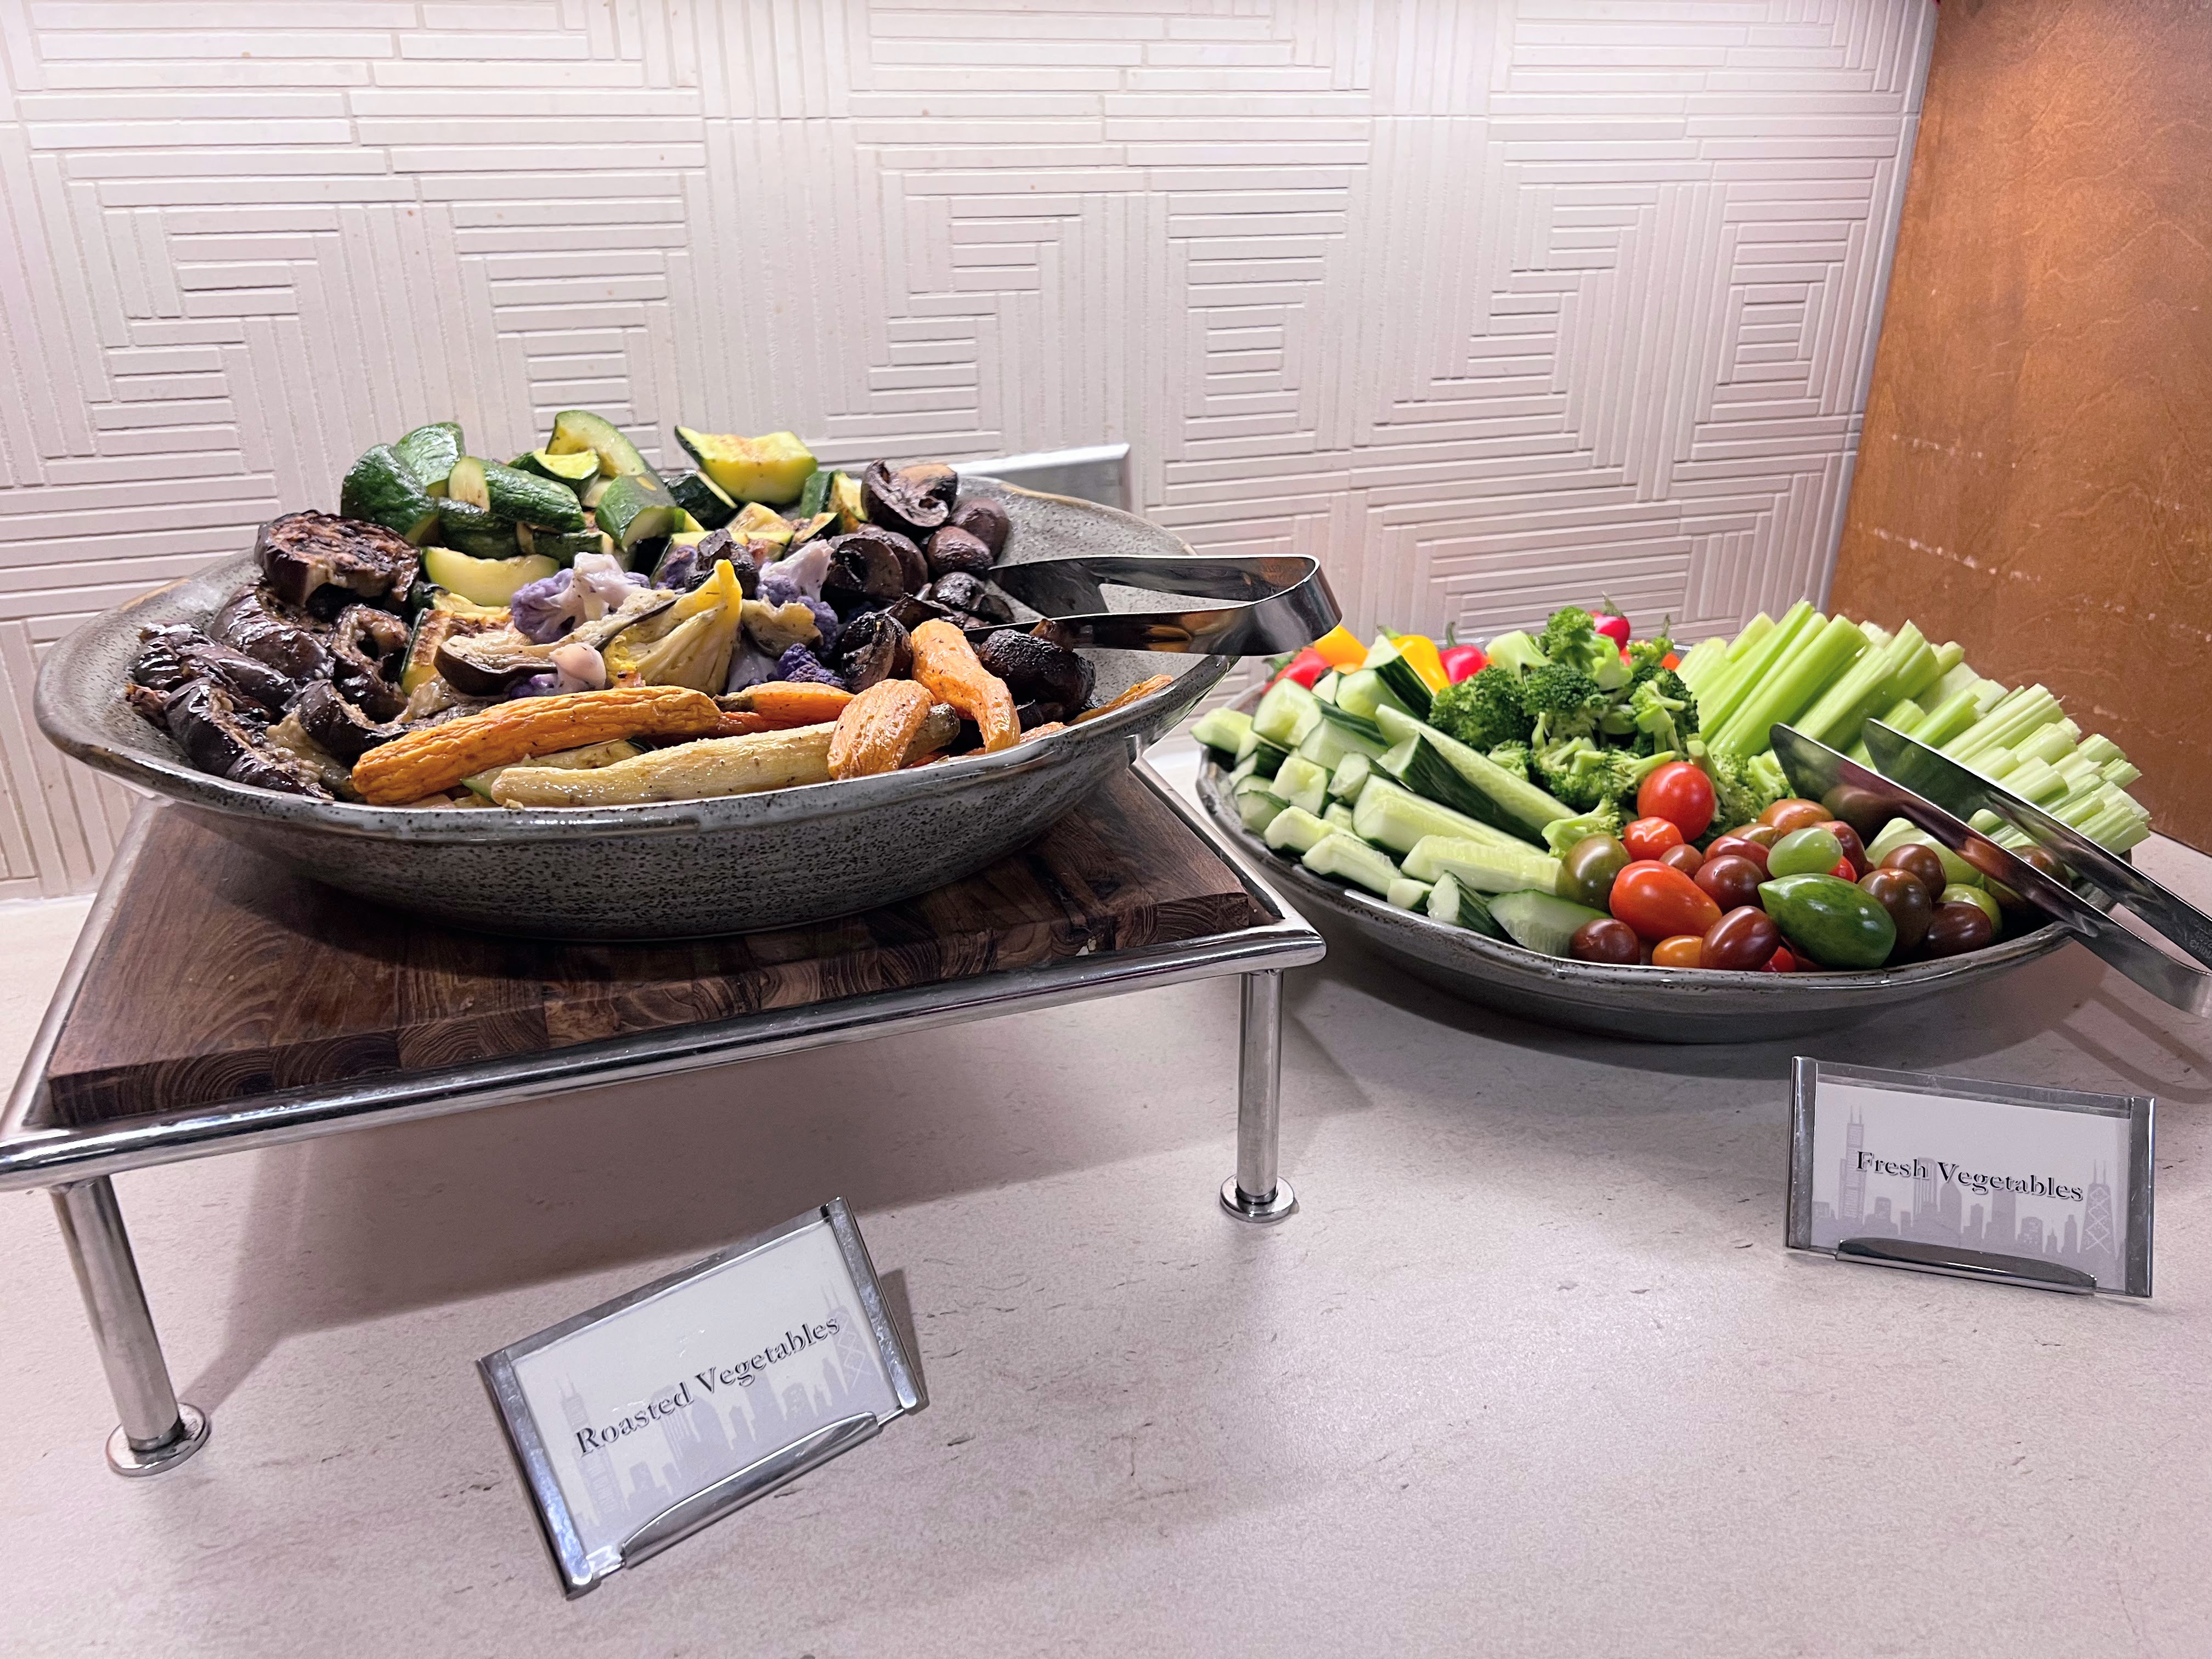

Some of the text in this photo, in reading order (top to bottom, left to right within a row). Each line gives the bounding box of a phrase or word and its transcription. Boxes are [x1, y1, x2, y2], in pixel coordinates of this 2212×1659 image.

[1856, 1150, 2084, 1202] Fresh Vegetables
[574, 1317, 840, 1460] Roasted Vegetables
